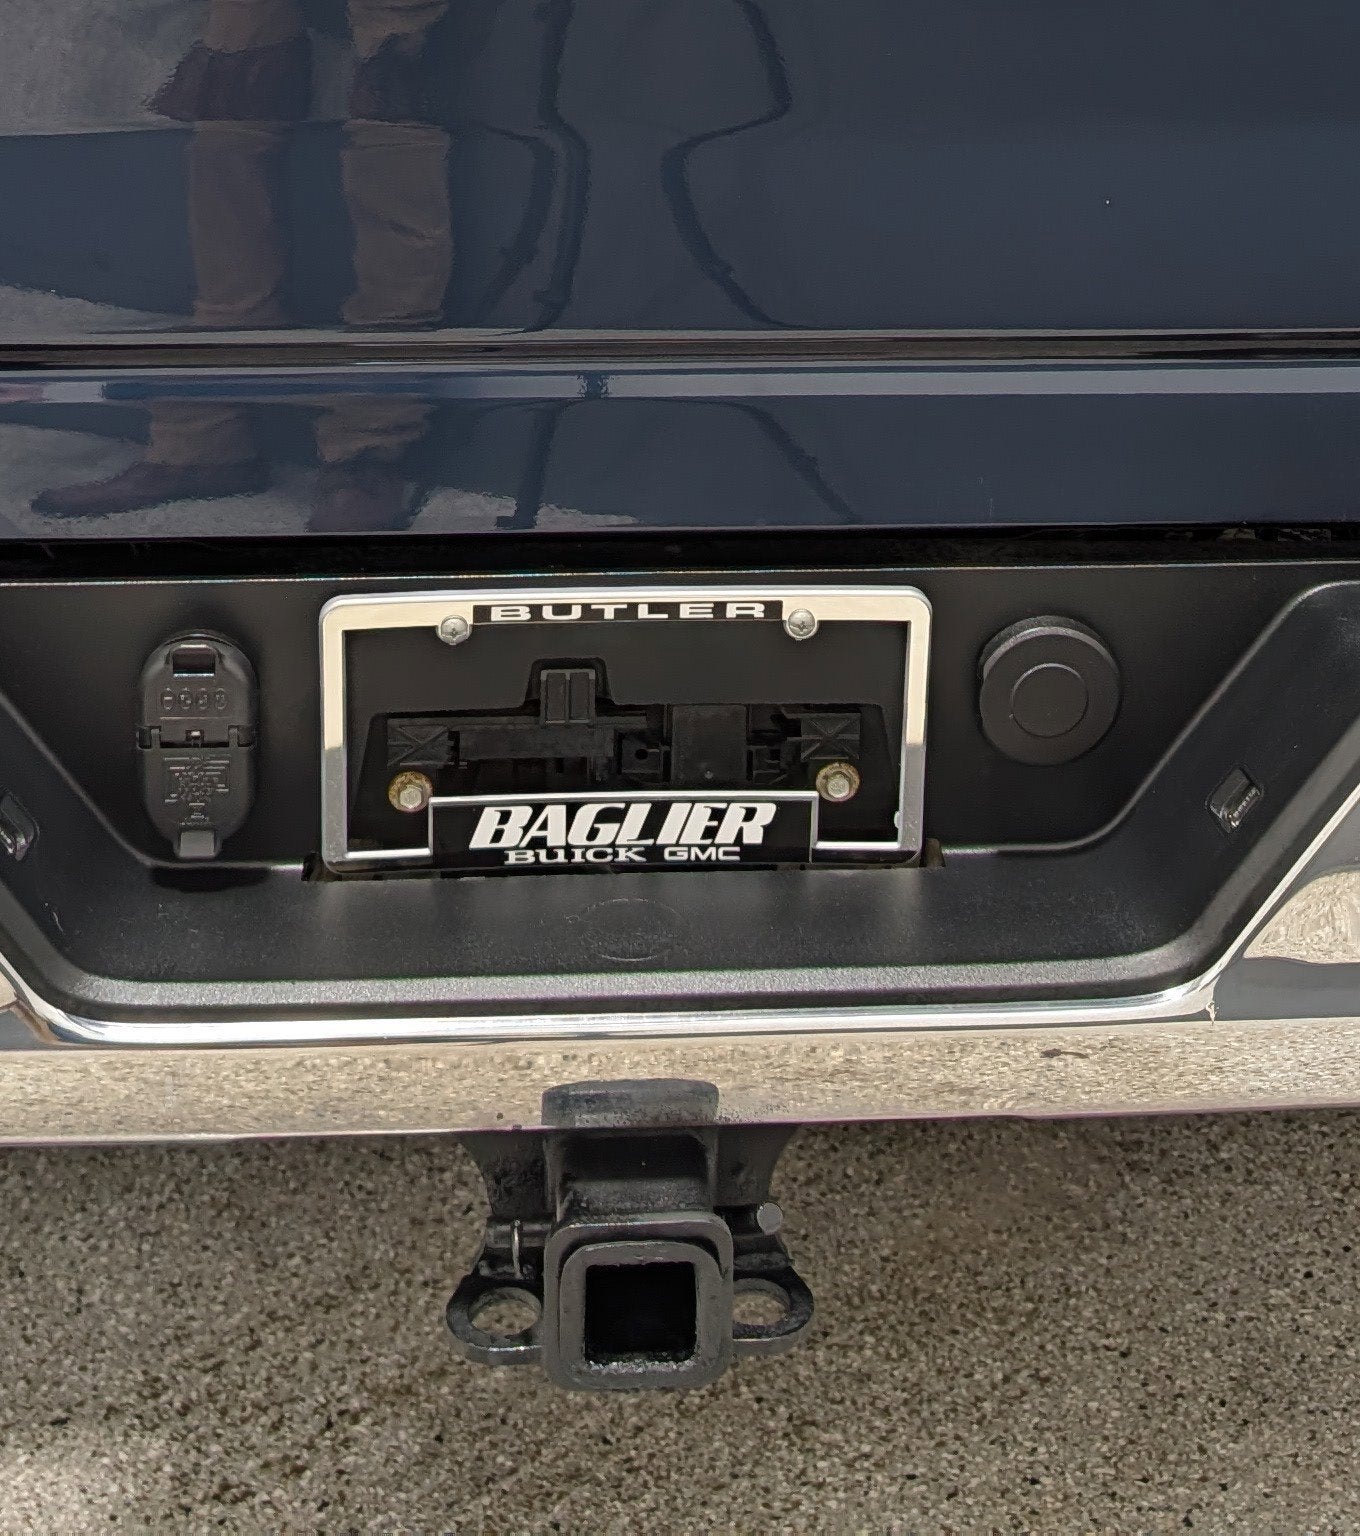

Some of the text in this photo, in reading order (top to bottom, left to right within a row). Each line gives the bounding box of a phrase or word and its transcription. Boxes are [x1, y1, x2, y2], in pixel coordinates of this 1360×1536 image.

[490, 602, 766, 622] BUTLER
[469, 801, 778, 850] BAGLIER
[504, 845, 741, 864] BUICK GMC
